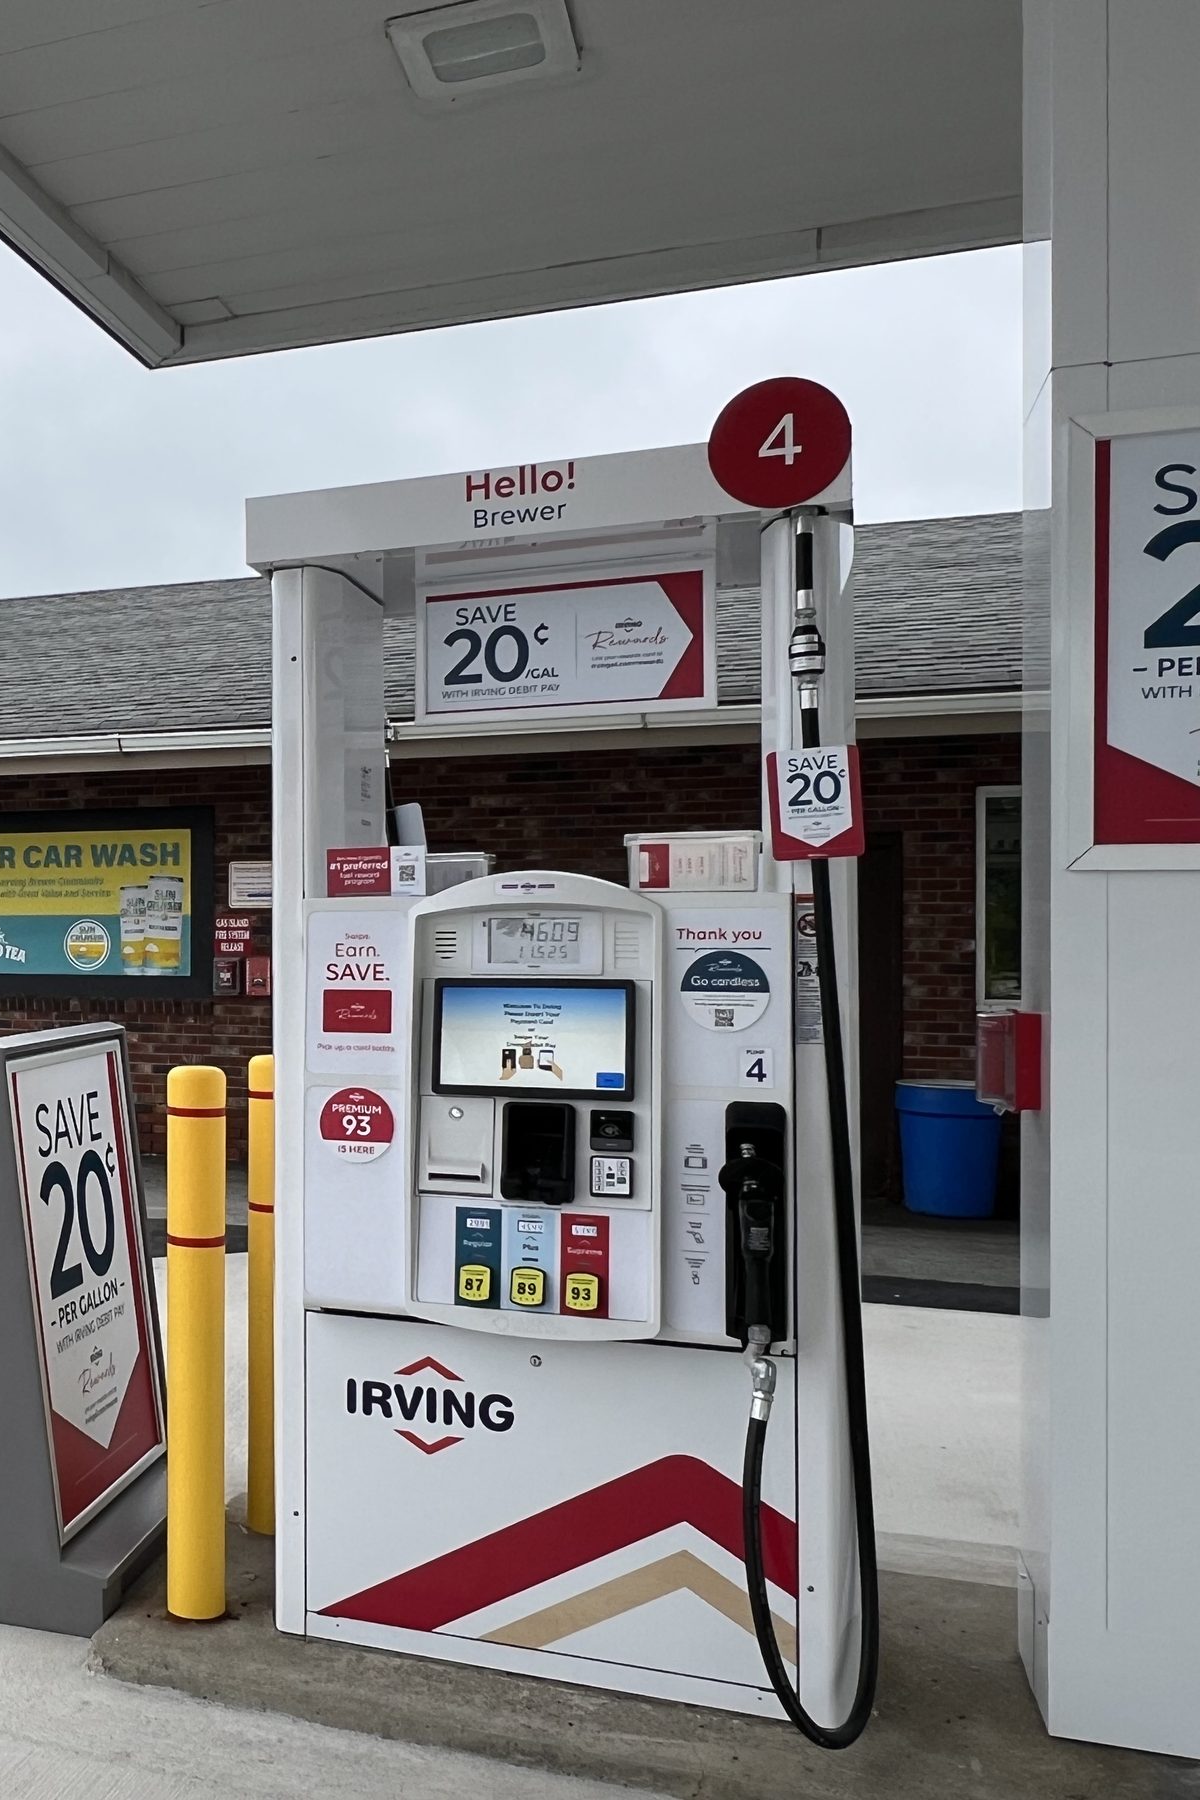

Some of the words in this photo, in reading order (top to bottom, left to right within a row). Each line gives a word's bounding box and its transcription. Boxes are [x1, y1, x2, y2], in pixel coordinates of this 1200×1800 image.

[758, 413, 803, 465] 4
[465, 461, 576, 502] Hello!
[473, 503, 567, 529] Brewer
[455, 603, 517, 626] SAVE
[1158, 656, 1200, 677] PE
[441, 690, 469, 699] WITH
[471, 687, 506, 697] IRVING
[509, 684, 538, 695] DEBIT
[1141, 685, 1192, 699] WITH
[788, 754, 838, 773] SAVE
[23, 844, 82, 869] CAR
[90, 842, 181, 868] WASH
[675, 928, 727, 941] Thank
[731, 930, 762, 943] you
[5, 944, 26, 964] TEA
[335, 943, 380, 958] Earn.
[325, 963, 390, 981] SAVE.
[691, 976, 708, 986] Go
[711, 976, 760, 987] cardless
[746, 1057, 767, 1082] 4
[332, 1103, 382, 1114] PREMIUM
[35, 1090, 102, 1158] SAVE
[342, 1115, 371, 1136] 93
[337, 1145, 348, 1154] IS
[349, 1146, 375, 1155] HERE
[464, 1278, 484, 1292] 87
[517, 1282, 536, 1296] 89
[571, 1287, 591, 1301] 93
[57, 1299, 78, 1330] PER
[78, 1277, 118, 1314] GALLON
[56, 1333, 75, 1354] WITH
[346, 1378, 515, 1432] IRVING
